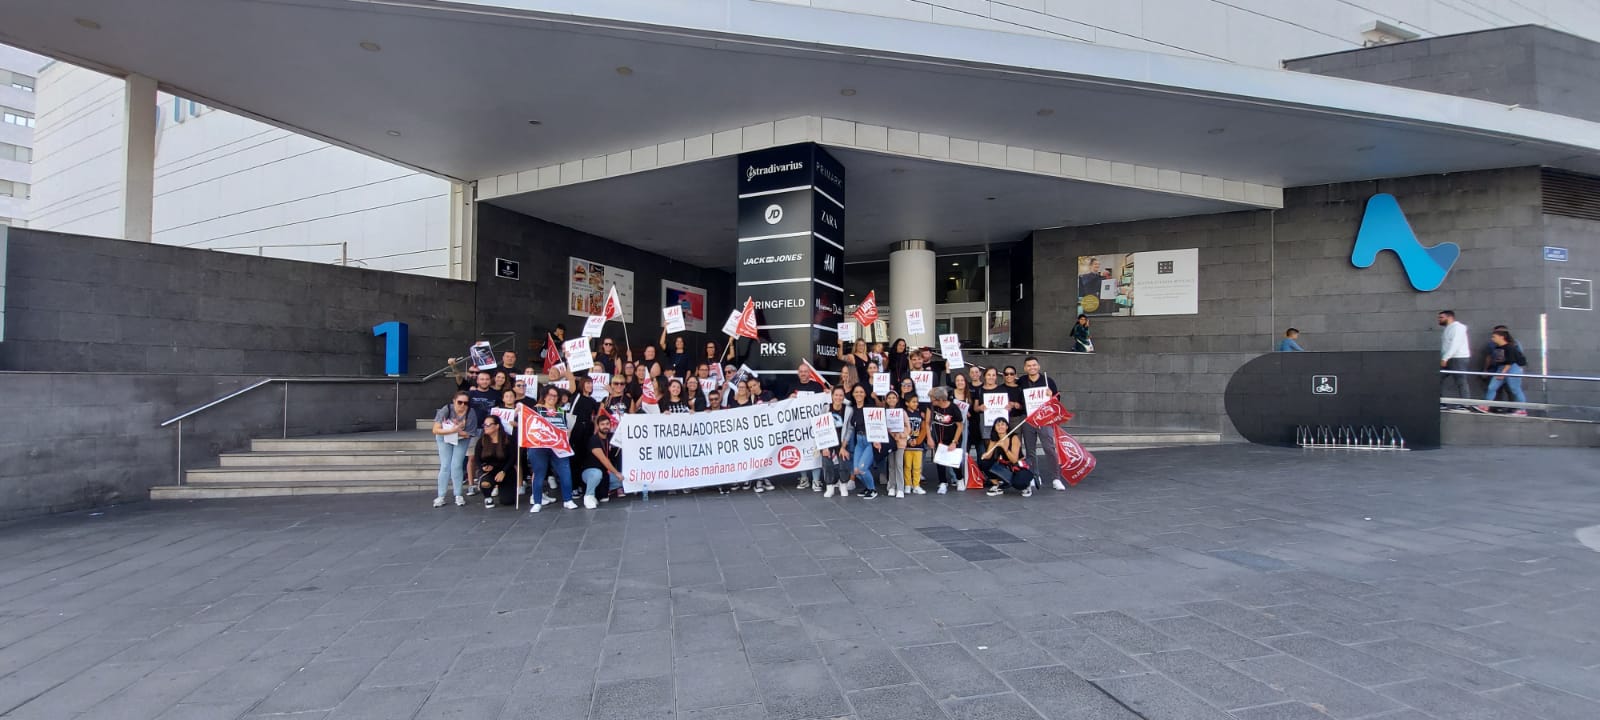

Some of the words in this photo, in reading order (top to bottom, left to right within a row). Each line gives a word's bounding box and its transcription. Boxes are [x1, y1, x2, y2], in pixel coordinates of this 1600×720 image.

[821, 210, 838, 229] ZARA
[743, 299, 806, 310] SRINGFIELD
[372, 321, 408, 376] 1
[760, 342, 787, 354] RKS
[1321, 377, 1329, 385] P
[627, 425, 648, 439] LOS
[653, 416, 749, 438] TRABAJADORES/AS
[753, 413, 773, 428] DEL
[639, 446, 652, 460] SE
[657, 443, 713, 459] MOVILIZAN
[717, 439, 739, 454] POR
[744, 435, 764, 451] SUS
[629, 468, 638, 481] Si
[641, 468, 656, 482] hoy
[658, 470, 669, 479] no
[671, 466, 699, 478] luchas
[701, 462, 735, 476] mañana
[737, 461, 748, 471] no
[750, 456, 773, 470] llores
